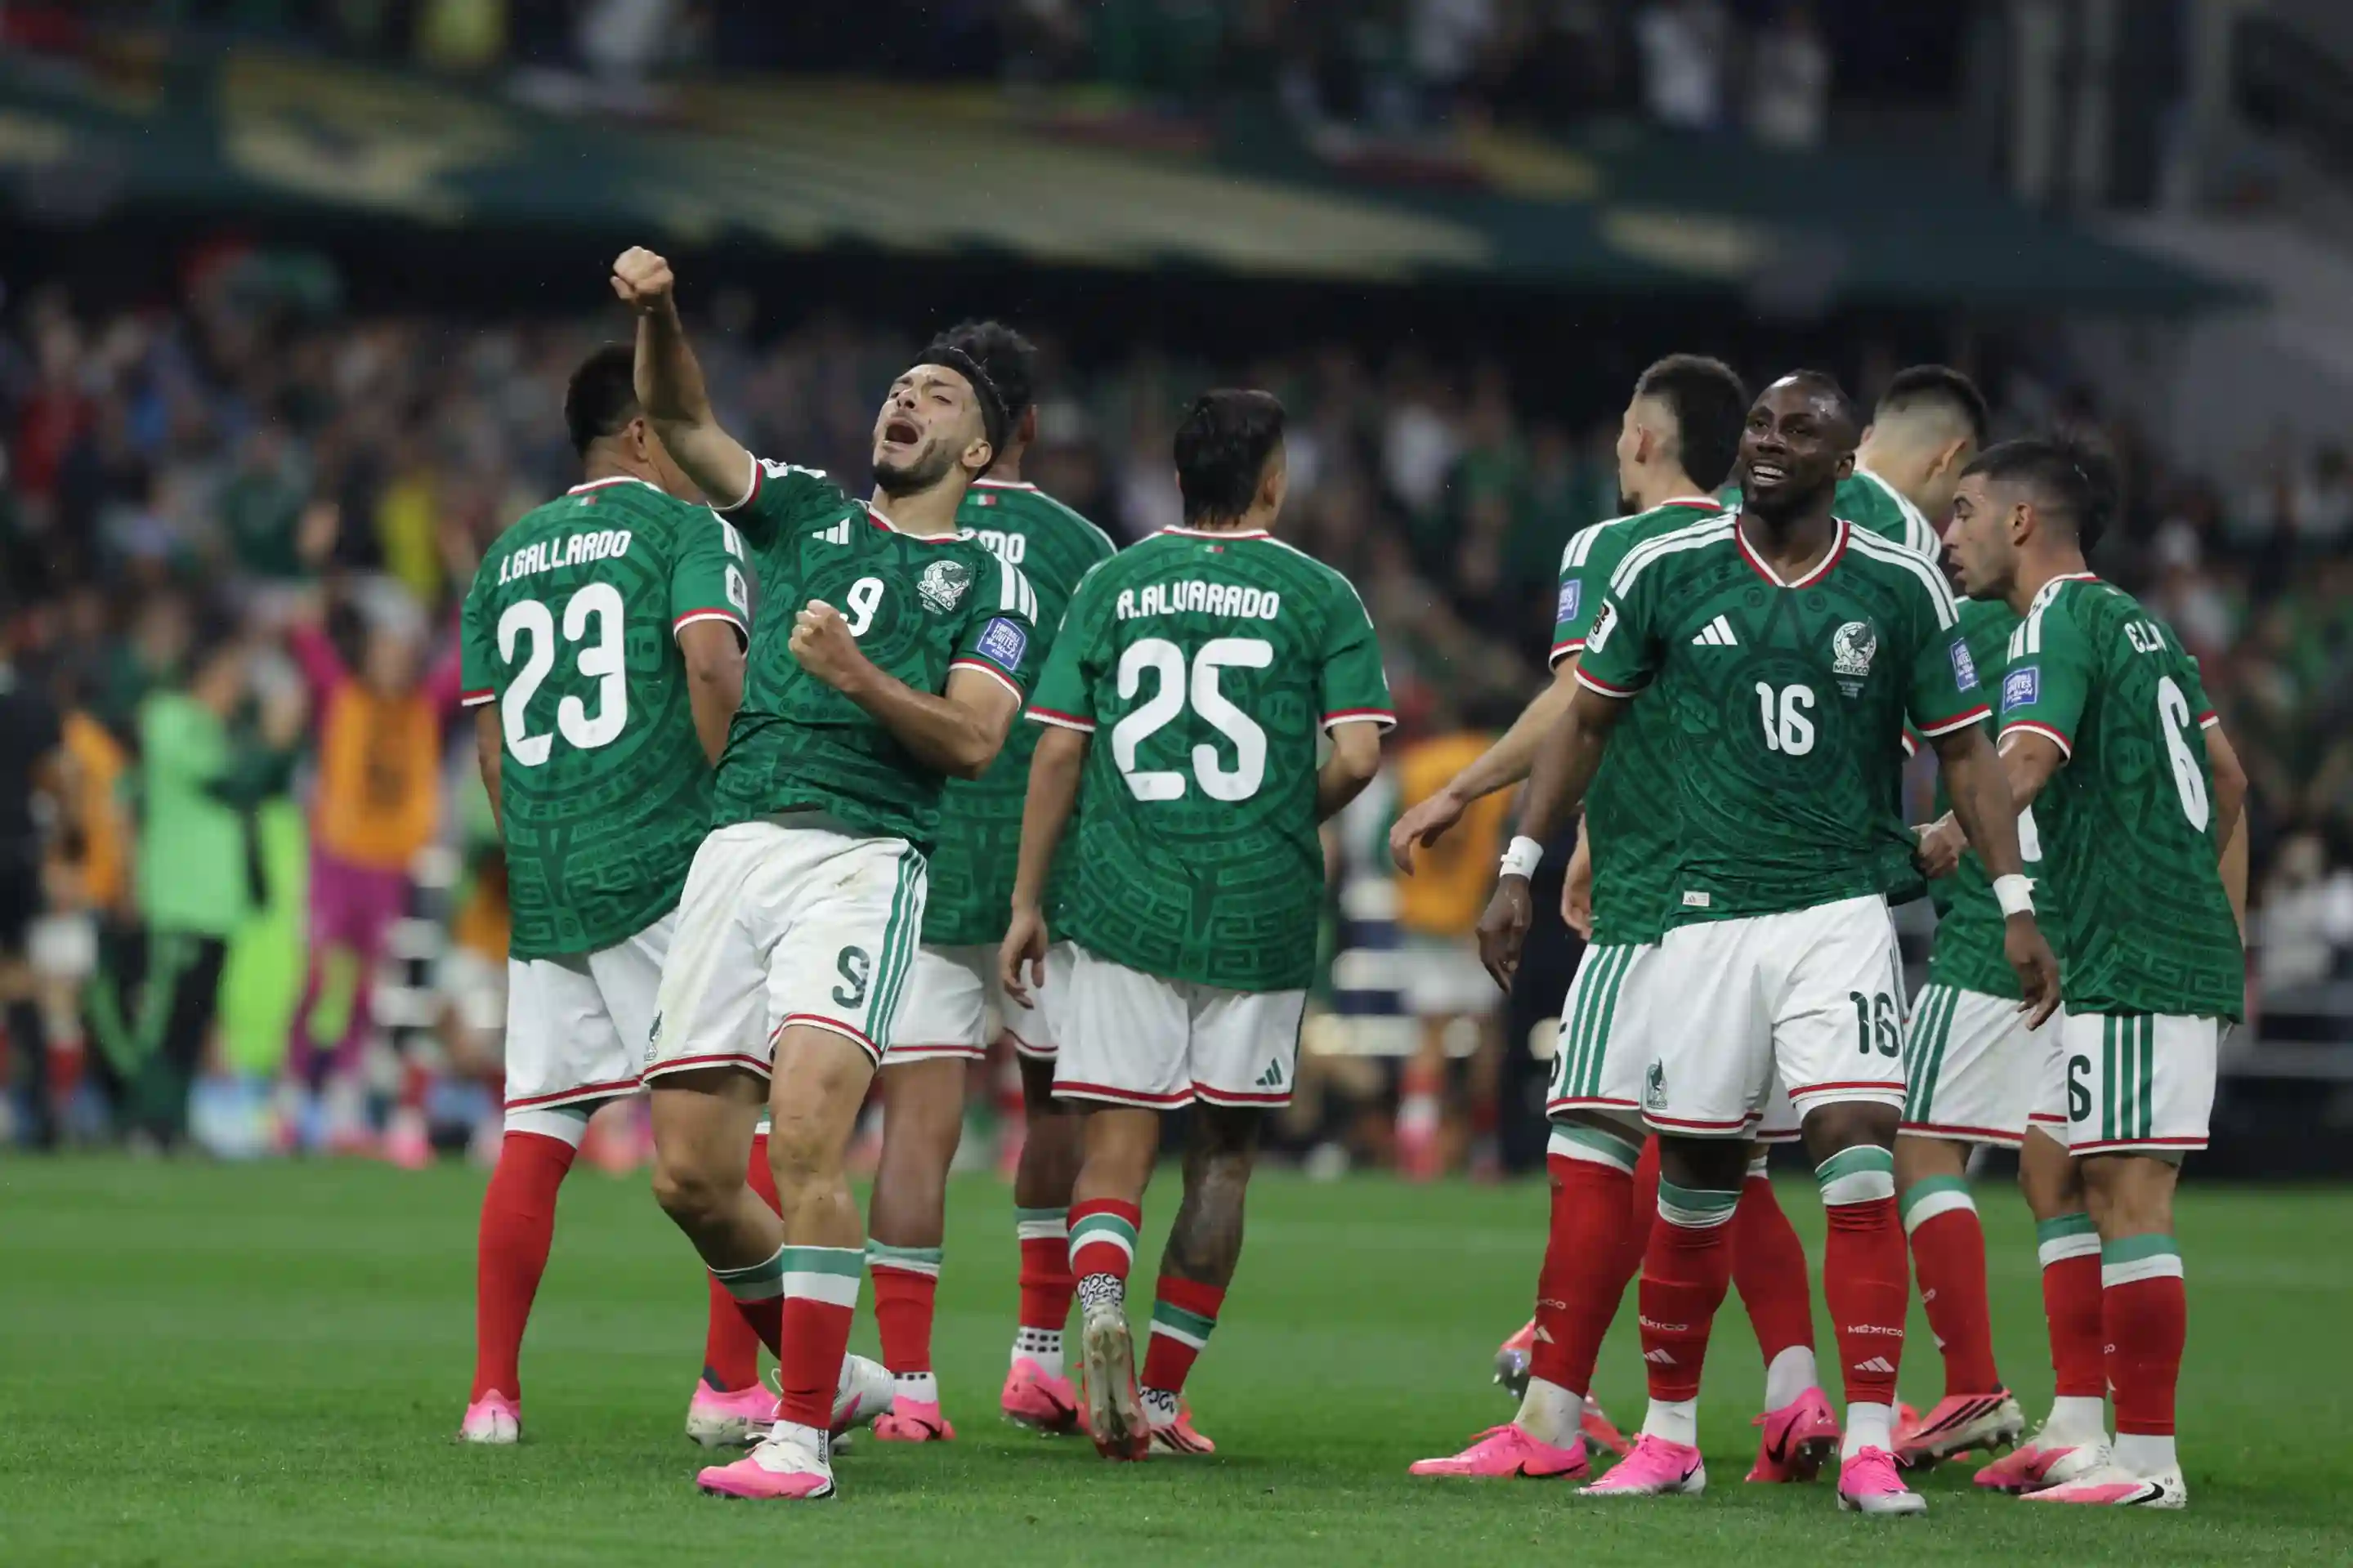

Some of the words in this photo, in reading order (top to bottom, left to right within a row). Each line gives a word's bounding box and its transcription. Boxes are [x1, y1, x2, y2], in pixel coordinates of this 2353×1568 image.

[498, 529, 632, 586] J.GALLARDO
[839, 577, 884, 637] 9
[1116, 580, 1280, 620] R.ALVARADO
[498, 582, 628, 766] 23
[1112, 637, 1273, 802] 25
[1755, 681, 1815, 756] 16
[2158, 675, 2209, 834] 6
[832, 945, 870, 1010] 9
[1849, 990, 1900, 1058] 16
[2067, 1053, 2092, 1123] 6
[1848, 1324, 1903, 1338] MÉXICO
